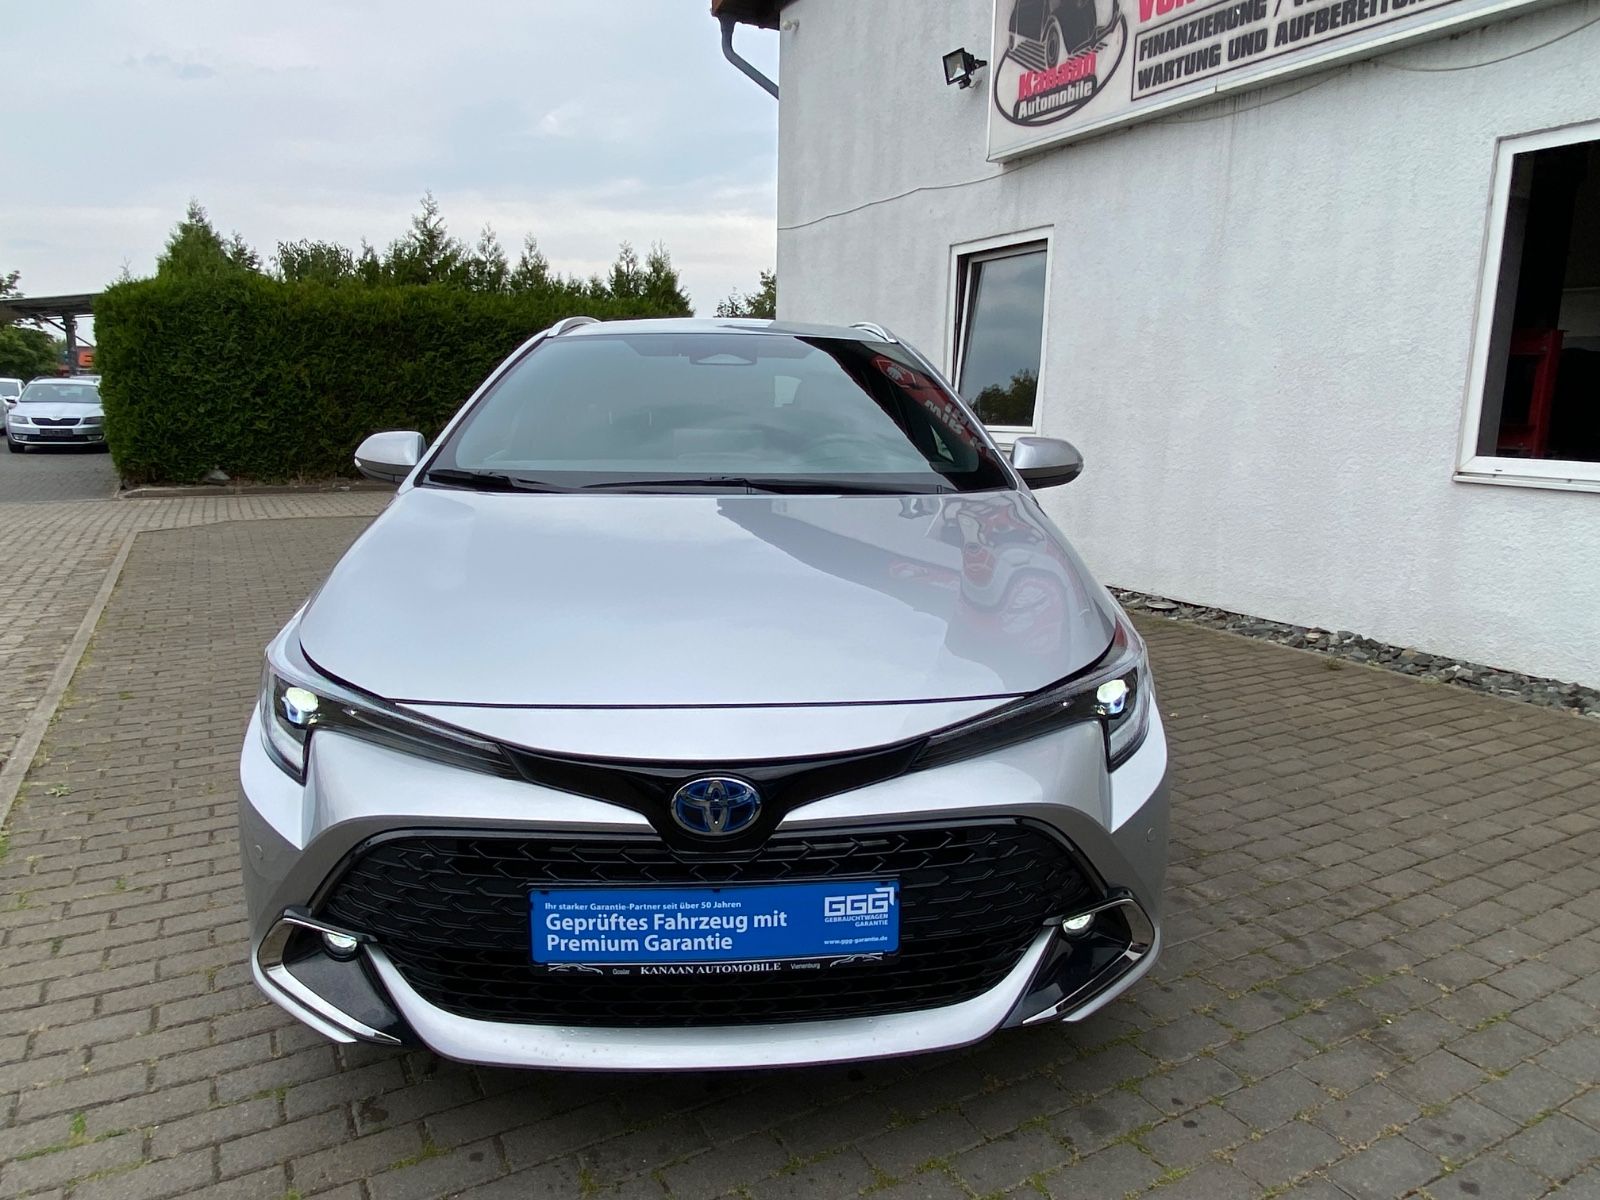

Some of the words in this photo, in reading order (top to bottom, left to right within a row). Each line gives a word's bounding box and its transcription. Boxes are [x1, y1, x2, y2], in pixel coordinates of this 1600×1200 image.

[1139, 0, 1267, 61] FINANZIERUNG
[1138, 44, 1221, 91] WARTUNG
[1227, 28, 1268, 62] UND
[1275, 0, 1424, 47] AUFBEREIT
[1018, 52, 1096, 100] Kanaan
[1018, 81, 1092, 119] Automobile
[545, 902, 557, 910] Ihr
[558, 903, 588, 911] starker
[590, 902, 660, 911] Garantie-Partner
[662, 902, 678, 910] seit
[679, 901, 699, 910] über
[701, 901, 712, 909] 50
[713, 901, 742, 909] Jahren
[824, 893, 889, 917] GGG
[546, 913, 648, 935] Geprüftes
[653, 912, 748, 933] Fahrzeug
[753, 910, 788, 928] mit
[824, 914, 889, 923] GEBRAUCHTWAGEN
[547, 934, 639, 952] Premium
[644, 933, 733, 951] Garantie
[640, 966, 694, 975] KANAAN
[696, 962, 782, 974] AUTOMOBILE
